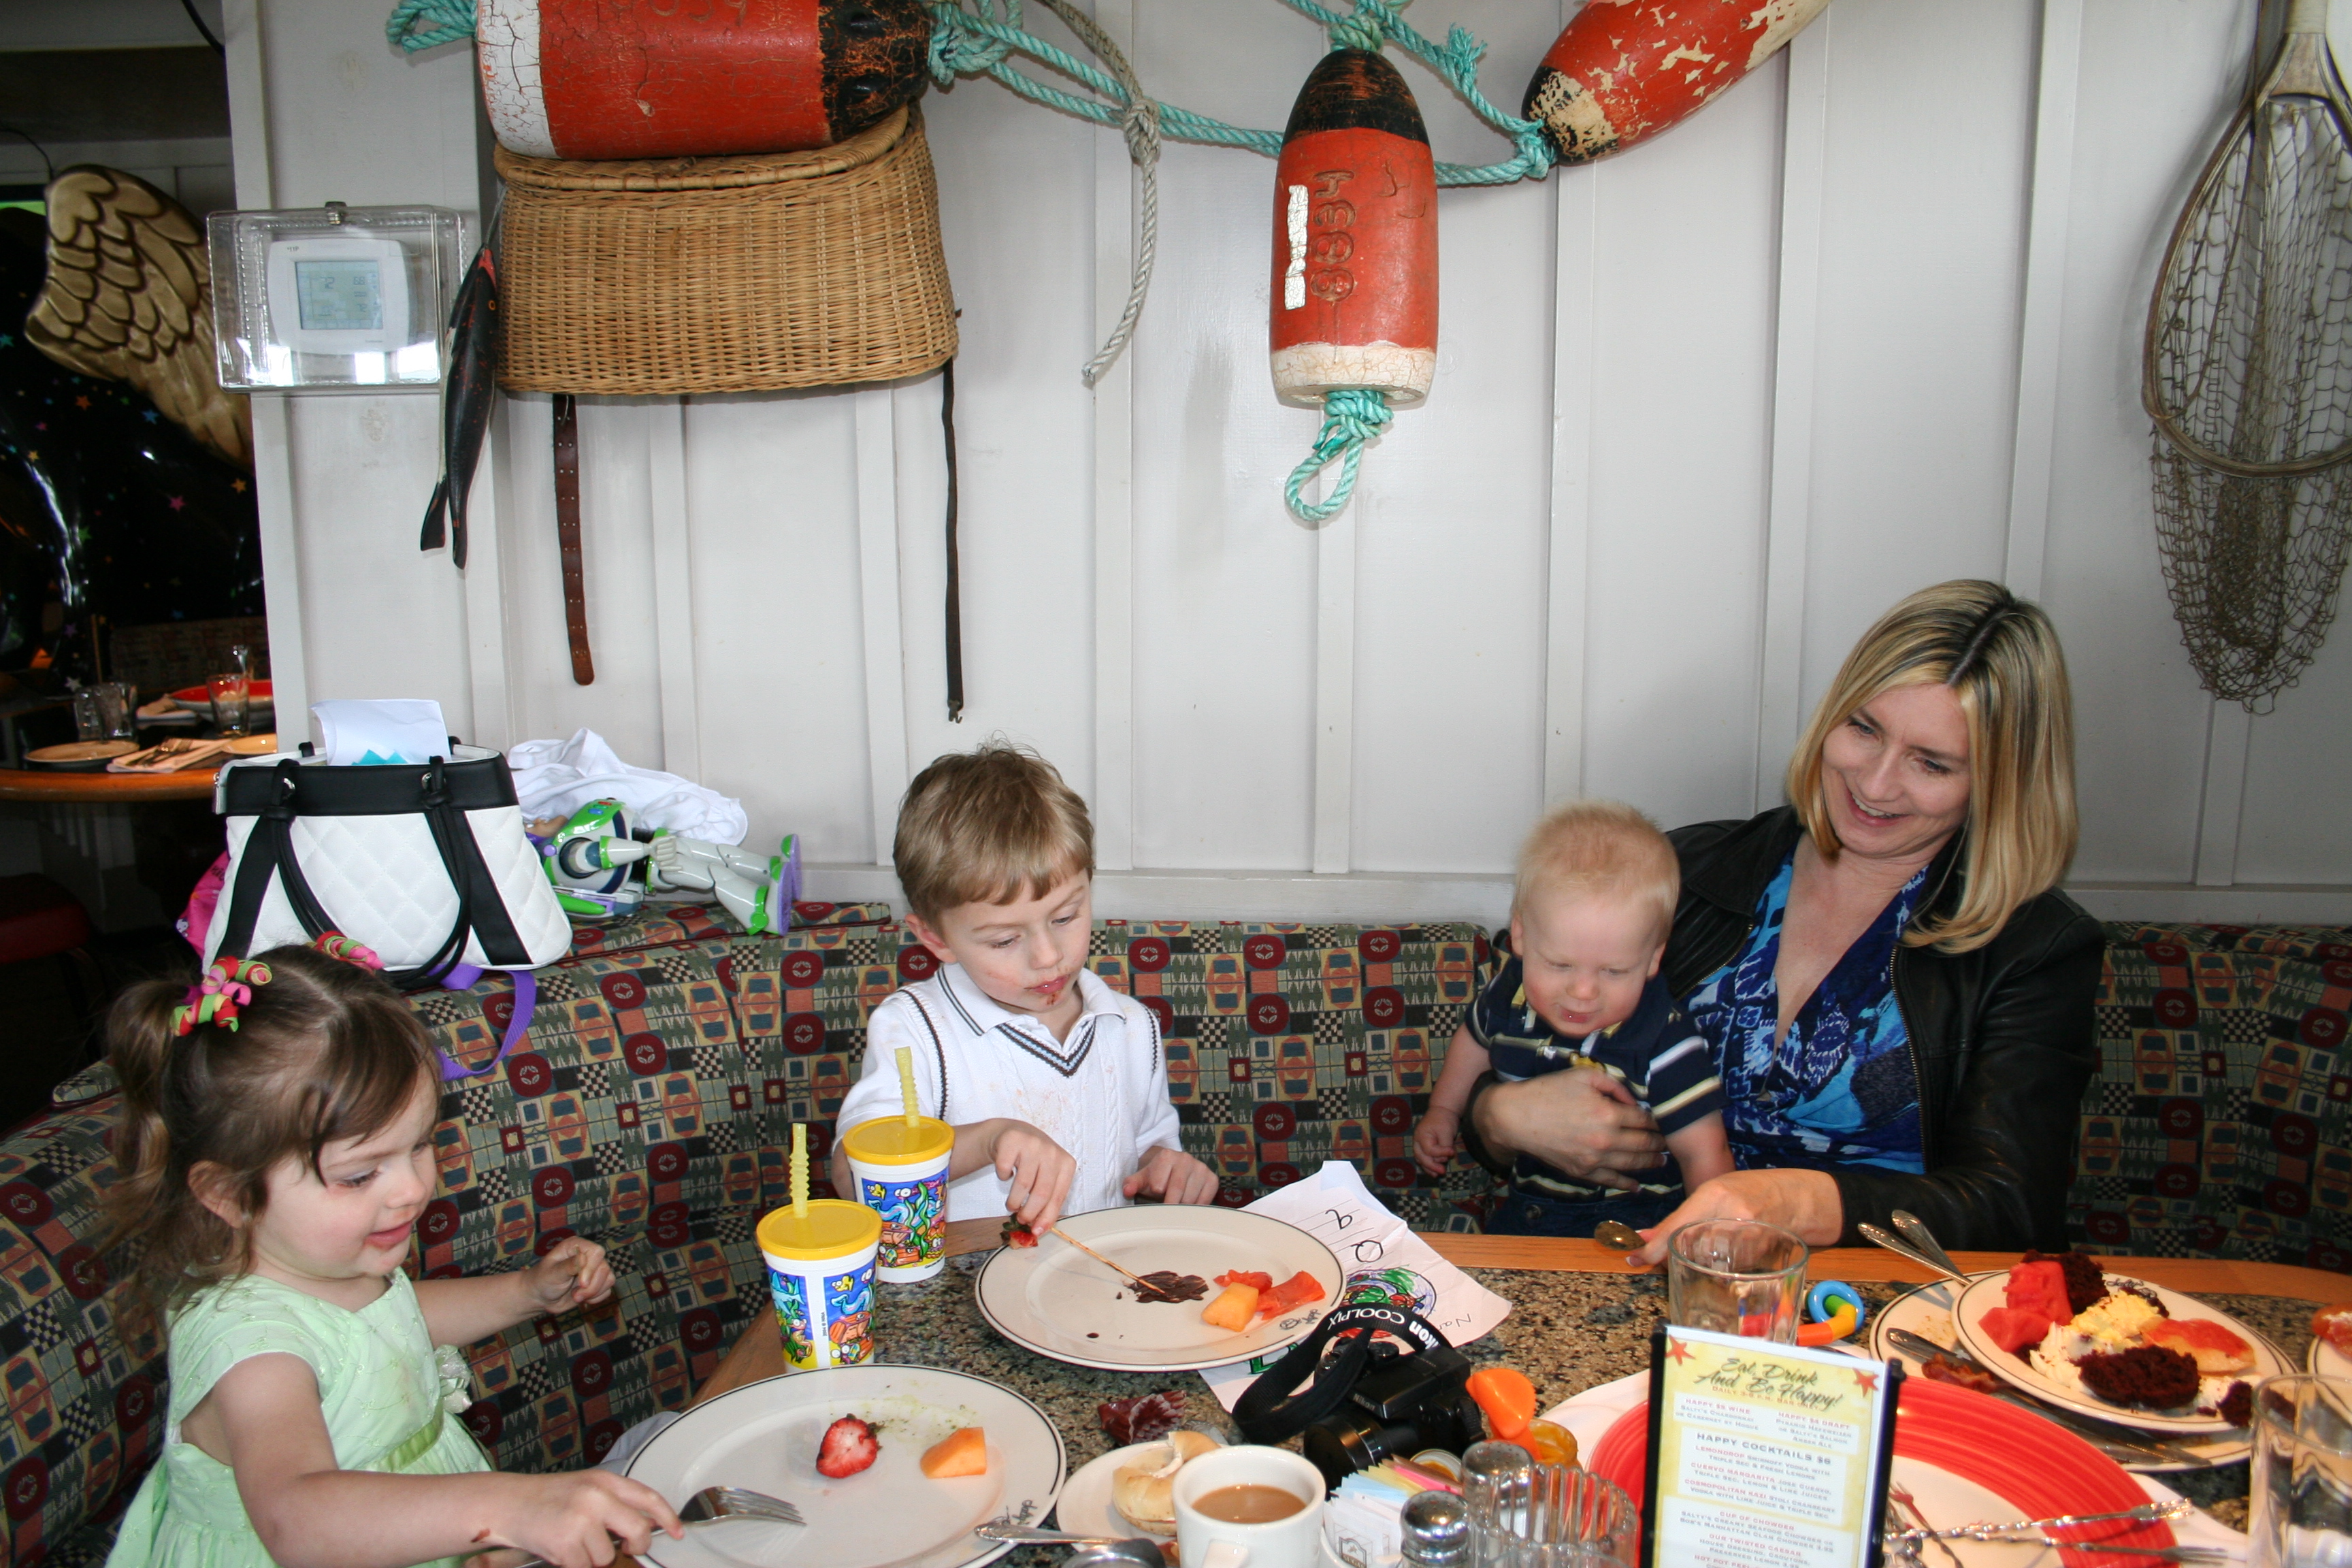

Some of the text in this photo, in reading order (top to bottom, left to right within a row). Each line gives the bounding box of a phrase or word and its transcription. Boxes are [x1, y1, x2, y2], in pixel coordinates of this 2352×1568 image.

[1309, 169, 1356, 302] 8834
[1327, 1307, 1405, 1330] COOLPIX
[1720, 1358, 1818, 1386] Eat, Drink
[1693, 1369, 1844, 1411] And Be Happy!
[1712, 1386, 1736, 1395] DAILY
[1685, 1398, 1712, 1408] HAPPY
[1728, 1405, 1750, 1415] WINE
[1778, 1412, 1806, 1422] HAPPY
[1822, 1420, 1849, 1431] DRAFT
[1695, 1444, 1745, 1460] LEMONDROP
[1696, 1432, 1737, 1447] HAPPY
[1742, 1441, 1812, 1462] COCKTAILS
[1690, 1462, 1724, 1473] CUERVO
[1727, 1469, 1775, 1483] MARGARITA
[1684, 1478, 1746, 1496] COSMOPOLITAN
[1748, 1491, 1767, 1499] KAZI
[1719, 1511, 1737, 1520] CUP
[1752, 1518, 1795, 1531] CHOWDER
[1729, 1537, 1765, 1549] TWISTED
[1767, 1546, 1801, 1556] CAESAR
